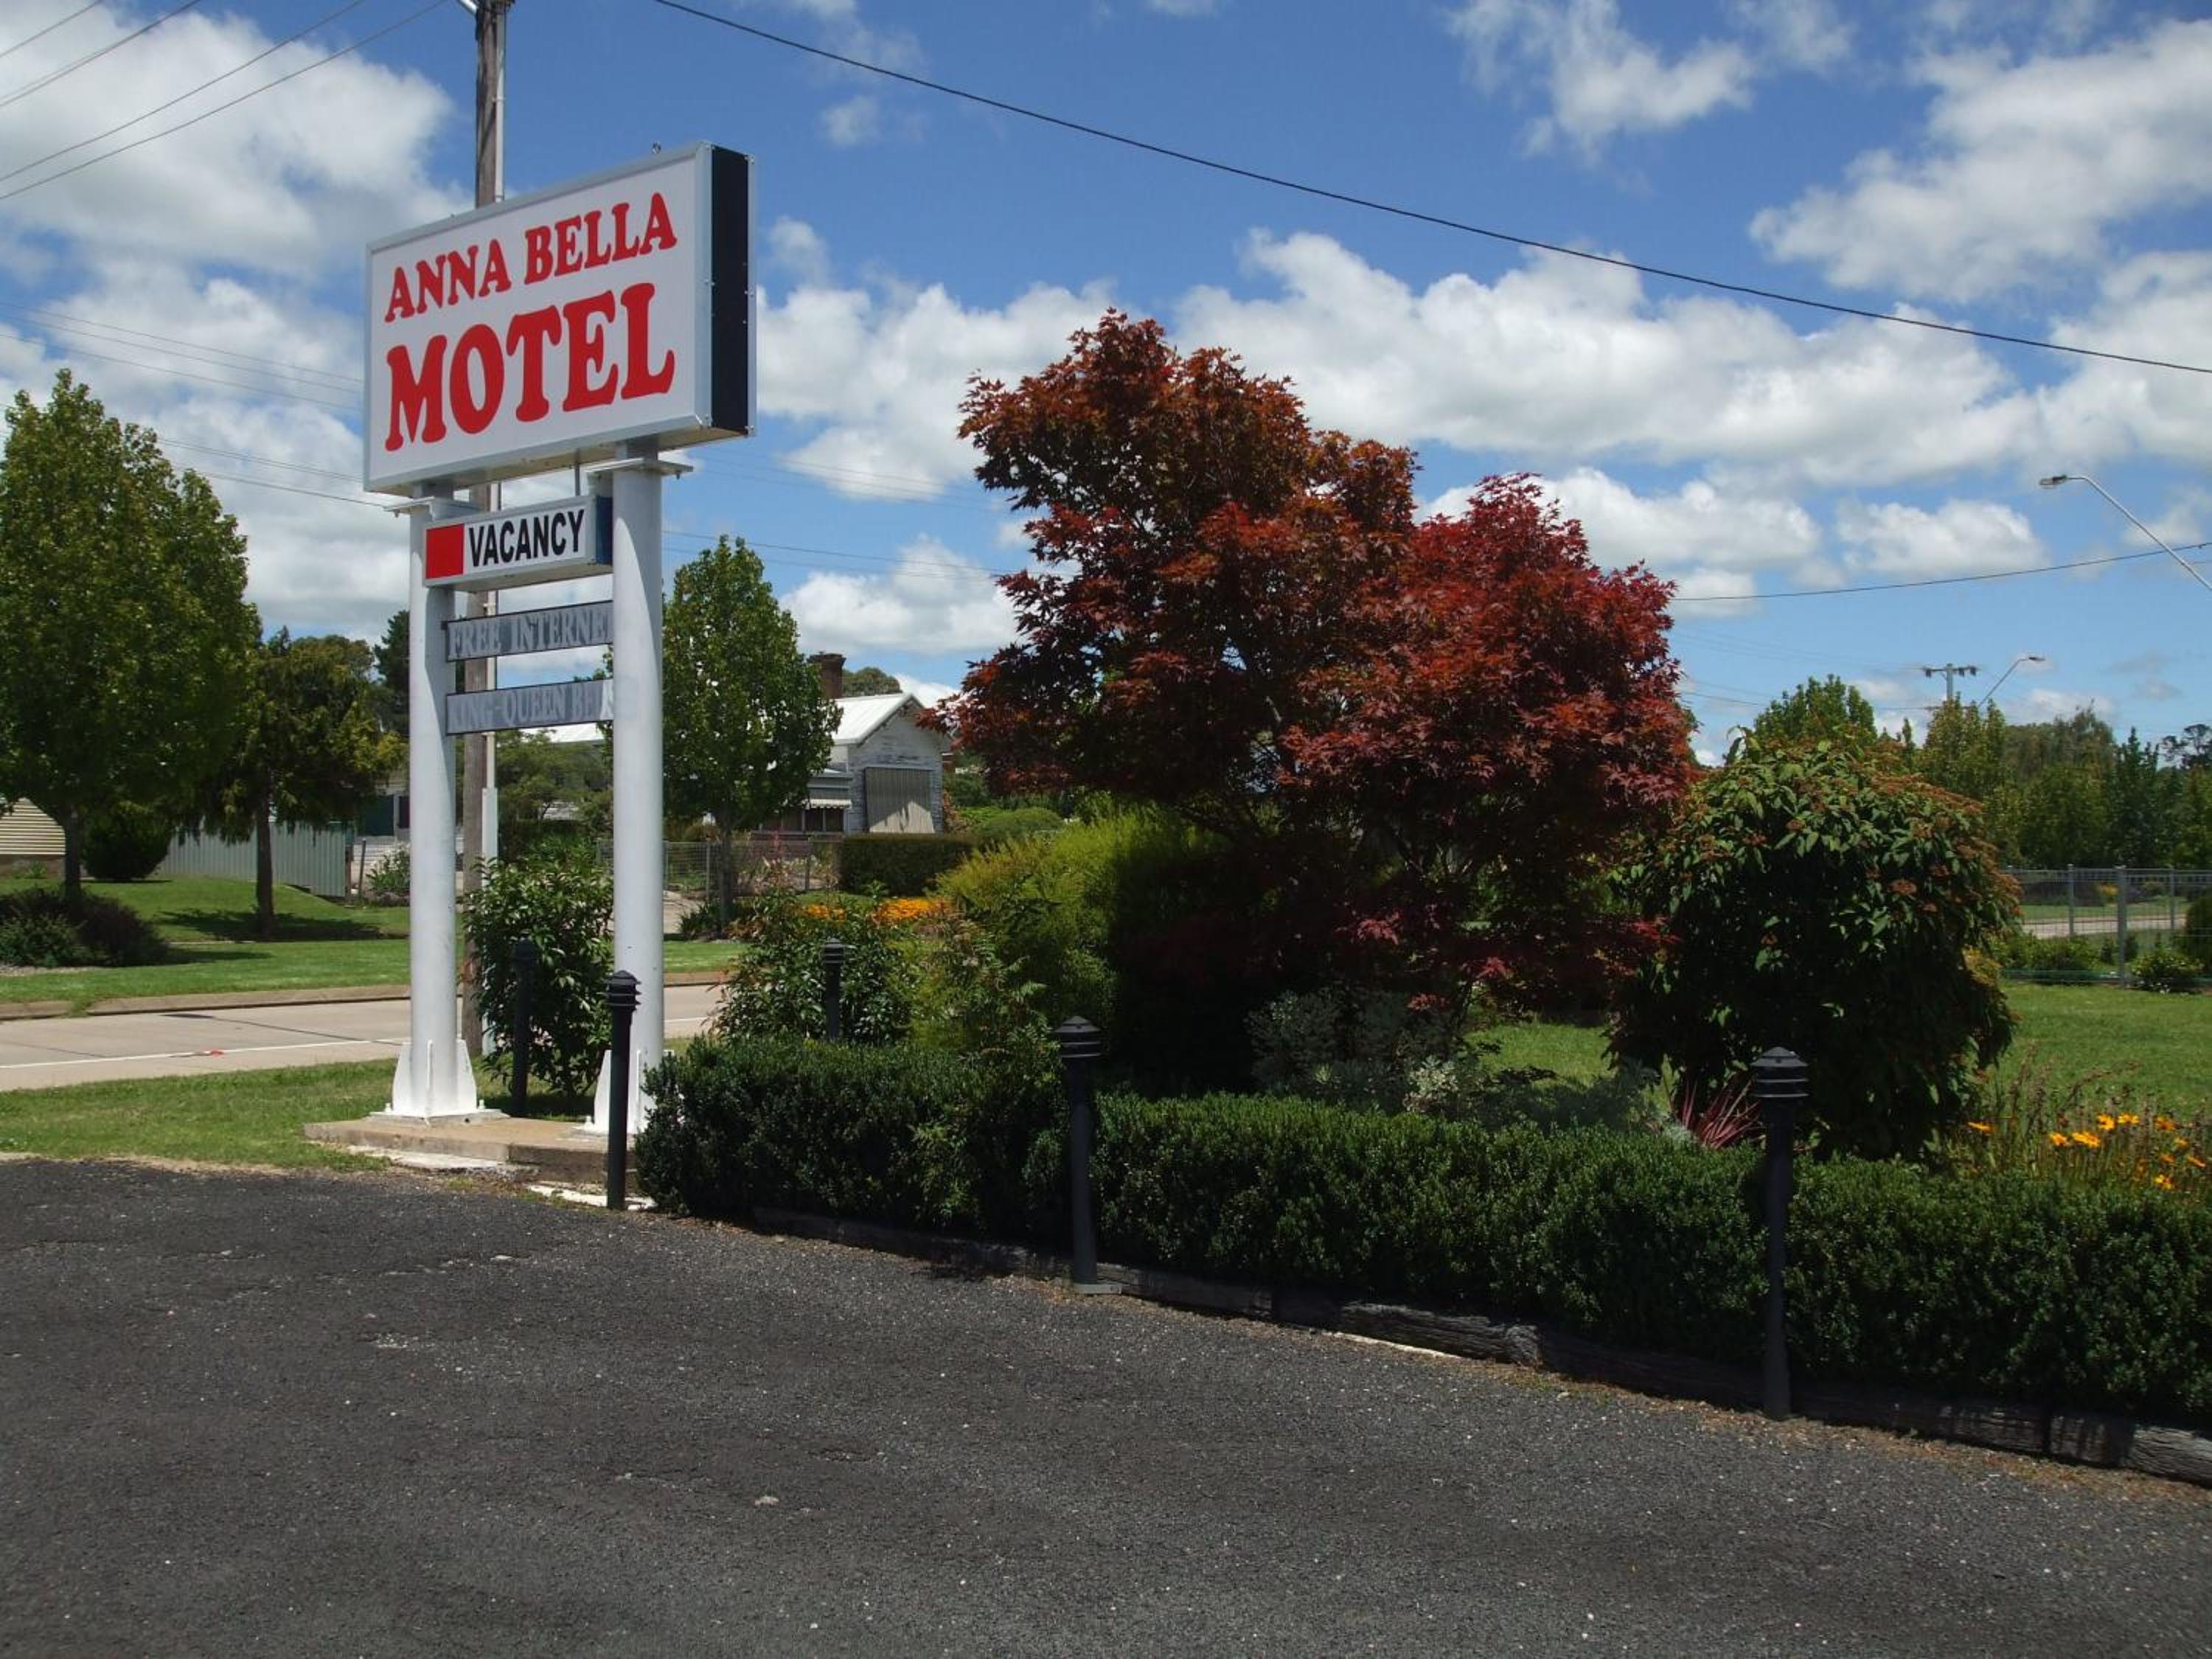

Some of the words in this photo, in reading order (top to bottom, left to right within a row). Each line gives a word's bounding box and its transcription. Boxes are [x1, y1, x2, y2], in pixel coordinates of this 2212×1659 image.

[384, 238, 512, 322] ANNA
[525, 192, 677, 285] BELLA
[385, 282, 675, 451] MOTEL
[469, 509, 585, 567] VACANCY
[448, 619, 502, 659] FREE
